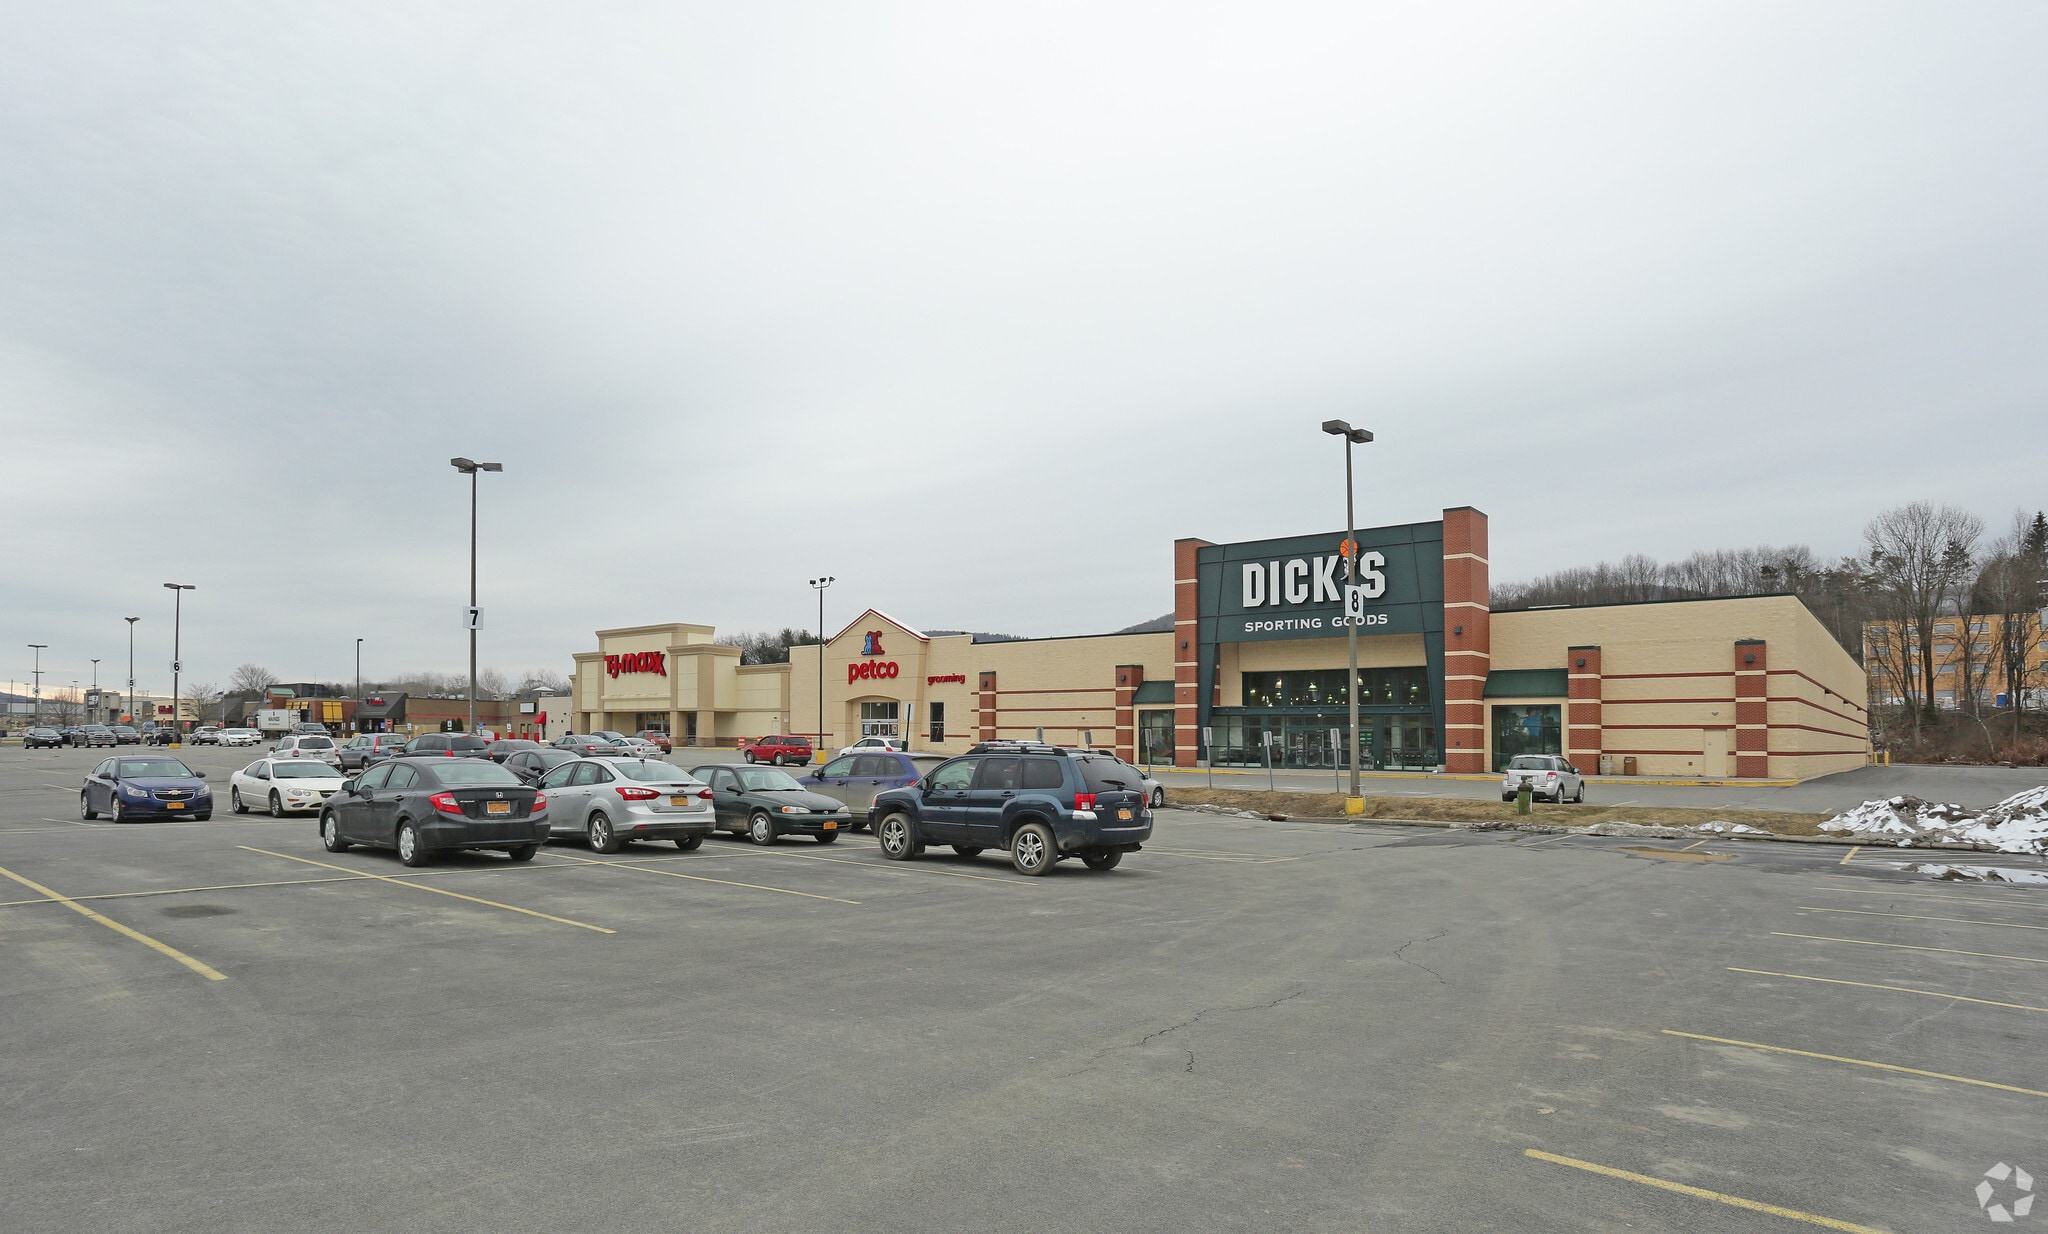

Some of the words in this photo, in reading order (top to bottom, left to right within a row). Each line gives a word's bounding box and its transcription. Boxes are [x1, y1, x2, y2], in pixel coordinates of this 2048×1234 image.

[1351, 589, 1360, 612] 8
[469, 609, 479, 626] 7
[1244, 618, 1322, 632] SPORTING
[1332, 614, 1388, 627] GOODS
[174, 662, 180, 671] 6
[848, 660, 899, 685] petco
[927, 673, 966, 686] grooming
